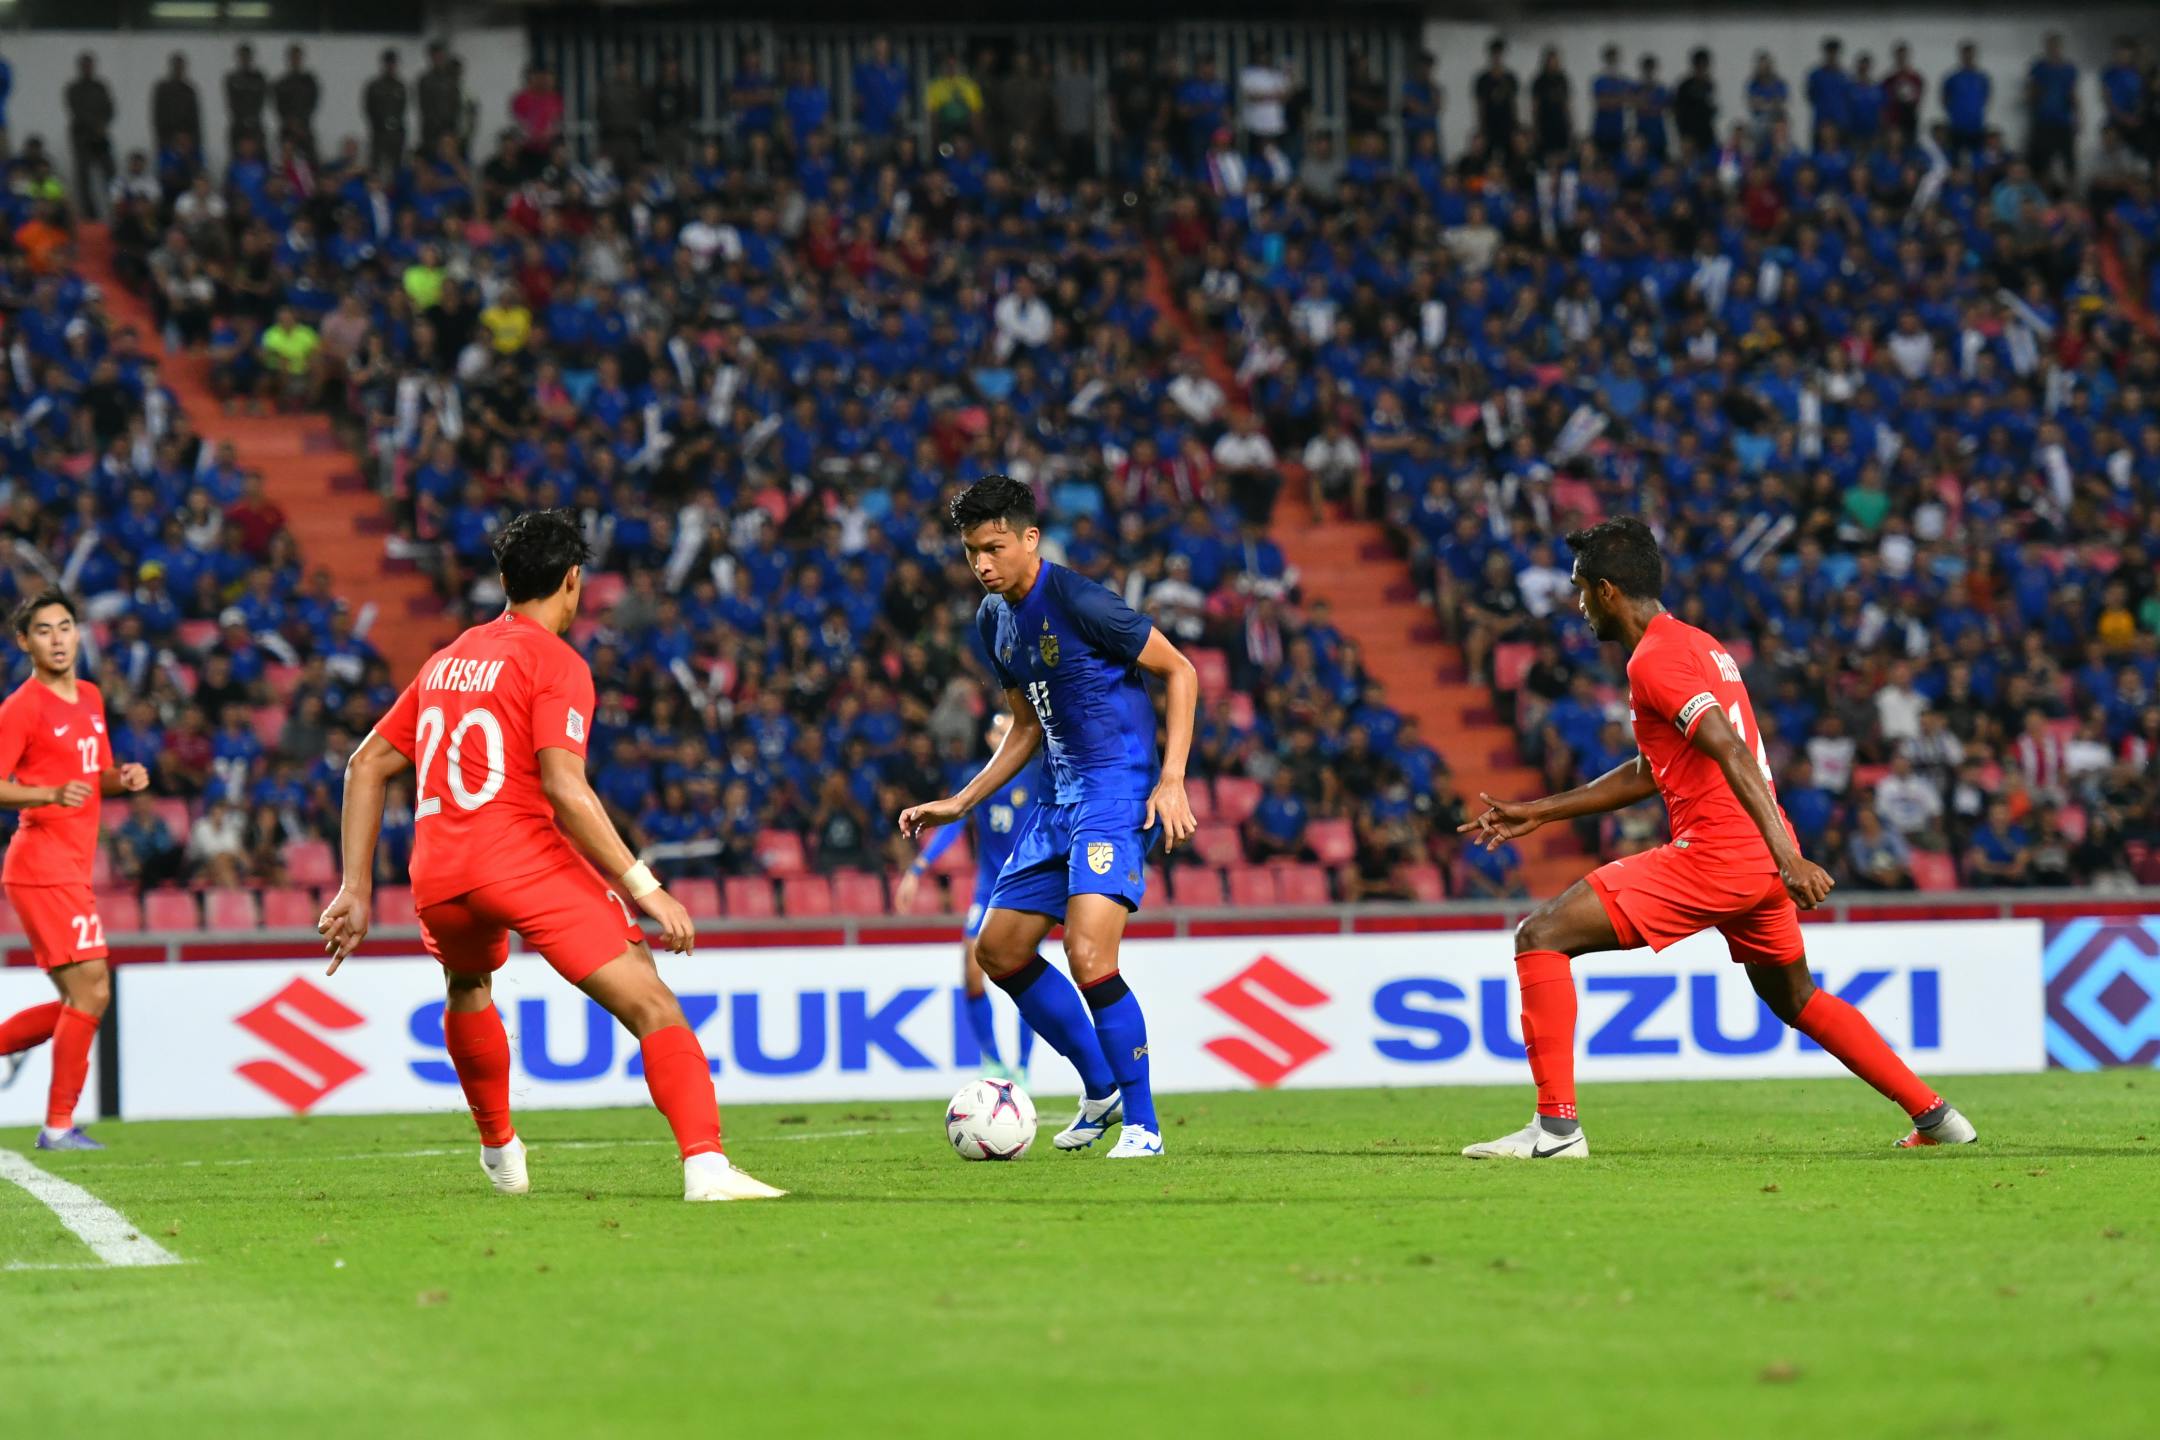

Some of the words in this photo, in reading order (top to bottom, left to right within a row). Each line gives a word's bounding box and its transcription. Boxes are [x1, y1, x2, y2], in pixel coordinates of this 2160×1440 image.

[425, 657, 505, 692] IKHSAN
[77, 736, 101, 774] 22
[415, 706, 505, 822] 20
[71, 912, 107, 951] 22
[1369, 967, 1941, 1065] SZUI
